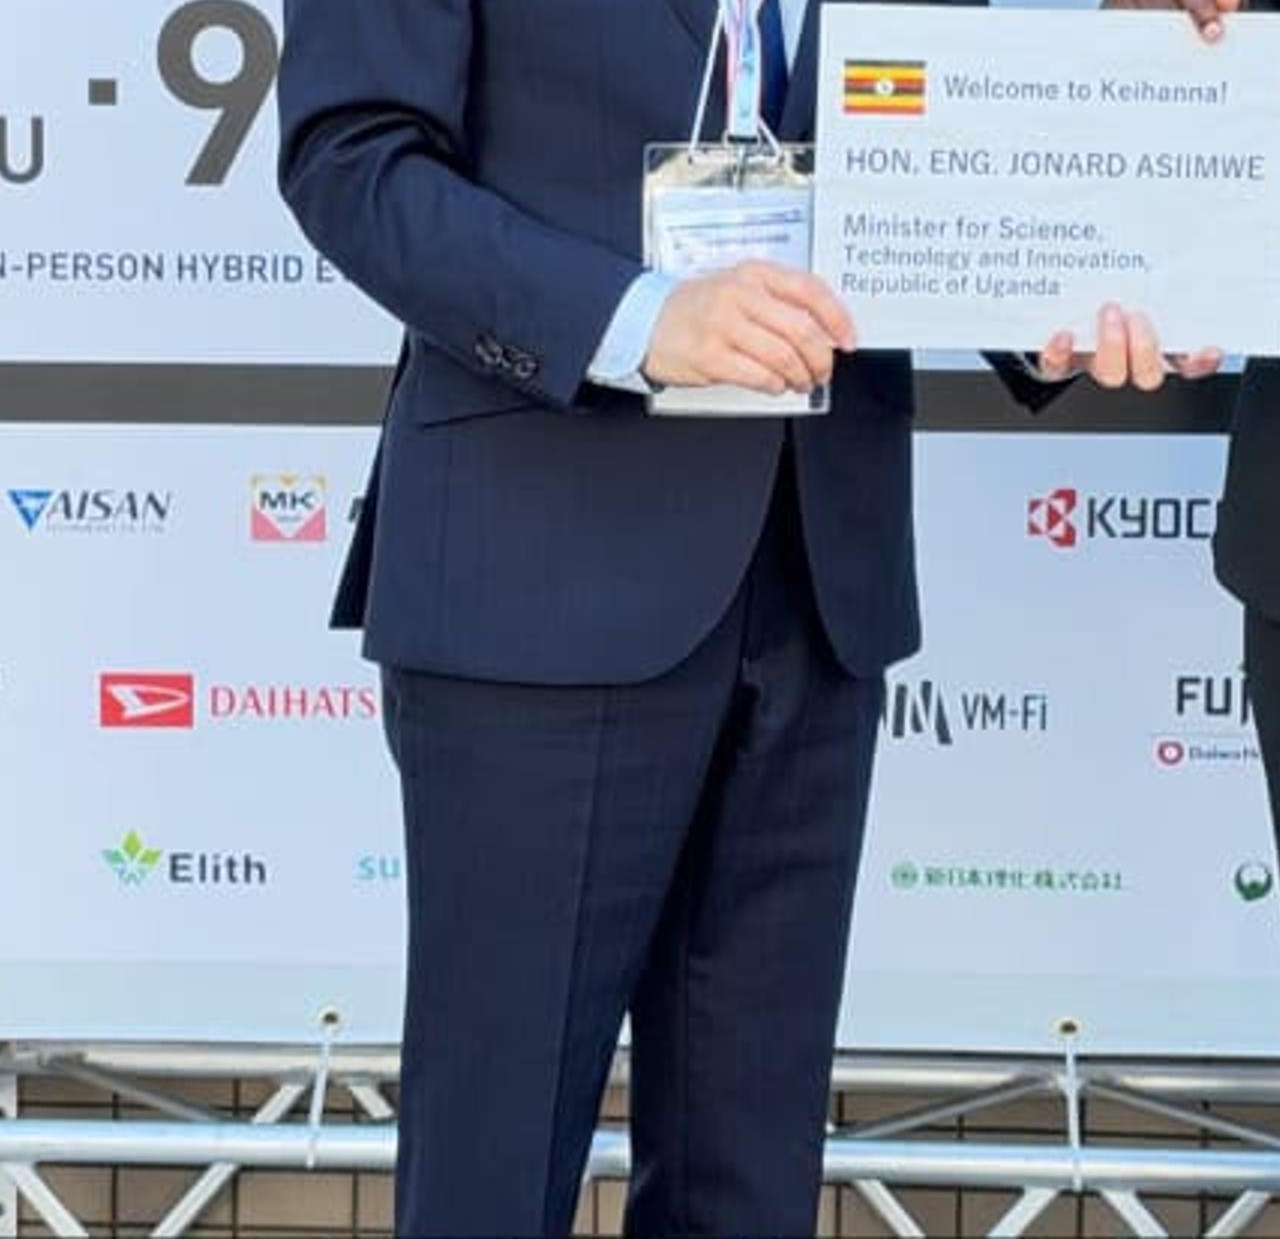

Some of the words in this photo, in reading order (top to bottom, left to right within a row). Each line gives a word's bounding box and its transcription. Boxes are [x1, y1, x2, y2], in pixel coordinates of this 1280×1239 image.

[943, 74, 1059, 101] Welcome
[1067, 80, 1091, 101] to
[1100, 77, 1227, 105] Keihanna!
[845, 149, 919, 178] HON.
[930, 150, 997, 178] ENG.
[1007, 152, 1125, 180] JONARD
[1134, 154, 1264, 182] ASIIMWE
[844, 213, 946, 240] Minister
[956, 214, 990, 240] for
[998, 217, 1104, 243] Science,
[177, 253, 303, 283] HYBRID
[844, 245, 970, 270] Technology
[979, 246, 1018, 268] and
[1026, 248, 1150, 272] Innovation,
[842, 272, 939, 296] Republic
[946, 273, 969, 296] of
[976, 274, 1060, 299] Uganda
[46, 490, 172, 520] AISAN
[259, 491, 315, 509] MK
[1087, 498, 1220, 538] KYOC
[210, 686, 377, 718] DAIHATS
[961, 694, 1047, 731] VM-Fi
[168, 852, 266, 885] Elith
